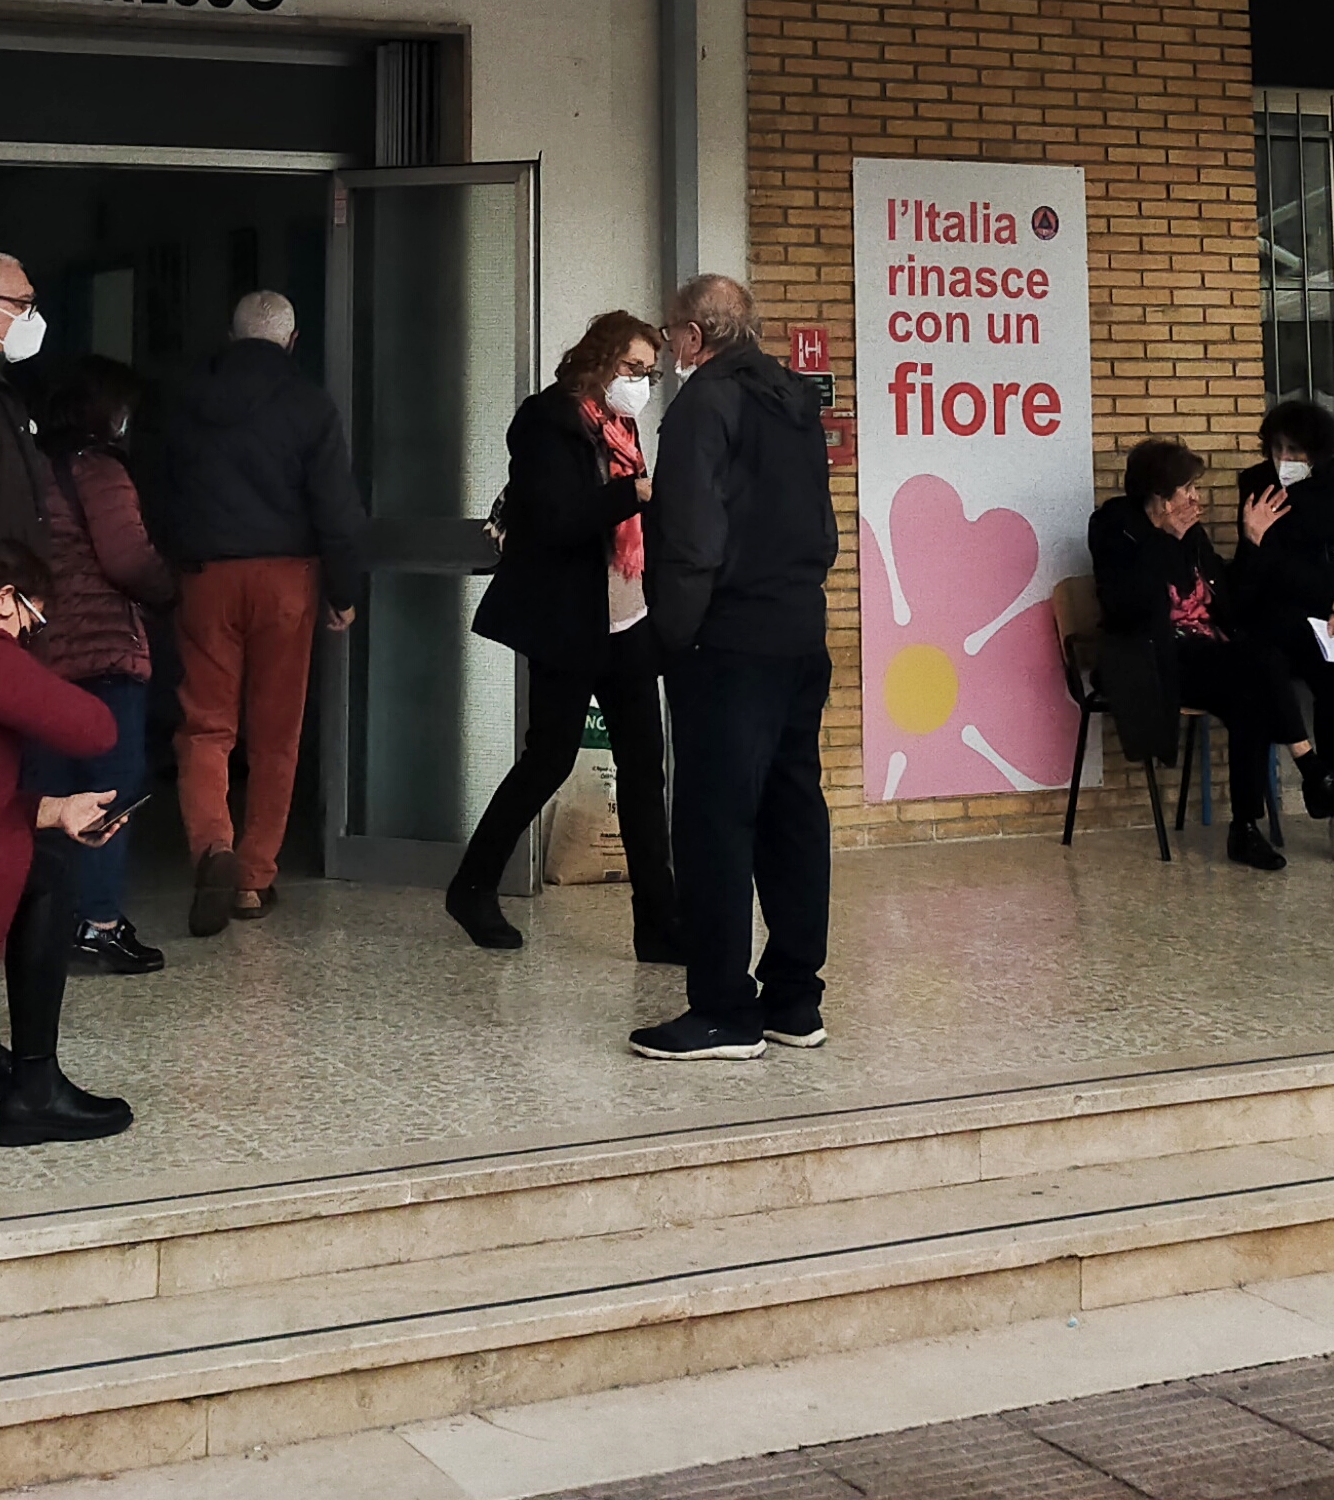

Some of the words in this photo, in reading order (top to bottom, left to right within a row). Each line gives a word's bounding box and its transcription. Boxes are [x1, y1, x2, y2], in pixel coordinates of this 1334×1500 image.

[887, 198, 1017, 245] l'Italia
[887, 254, 1050, 300] rinasce
[887, 311, 971, 343] con
[987, 313, 1041, 345] un
[887, 361, 1062, 438] fiore
